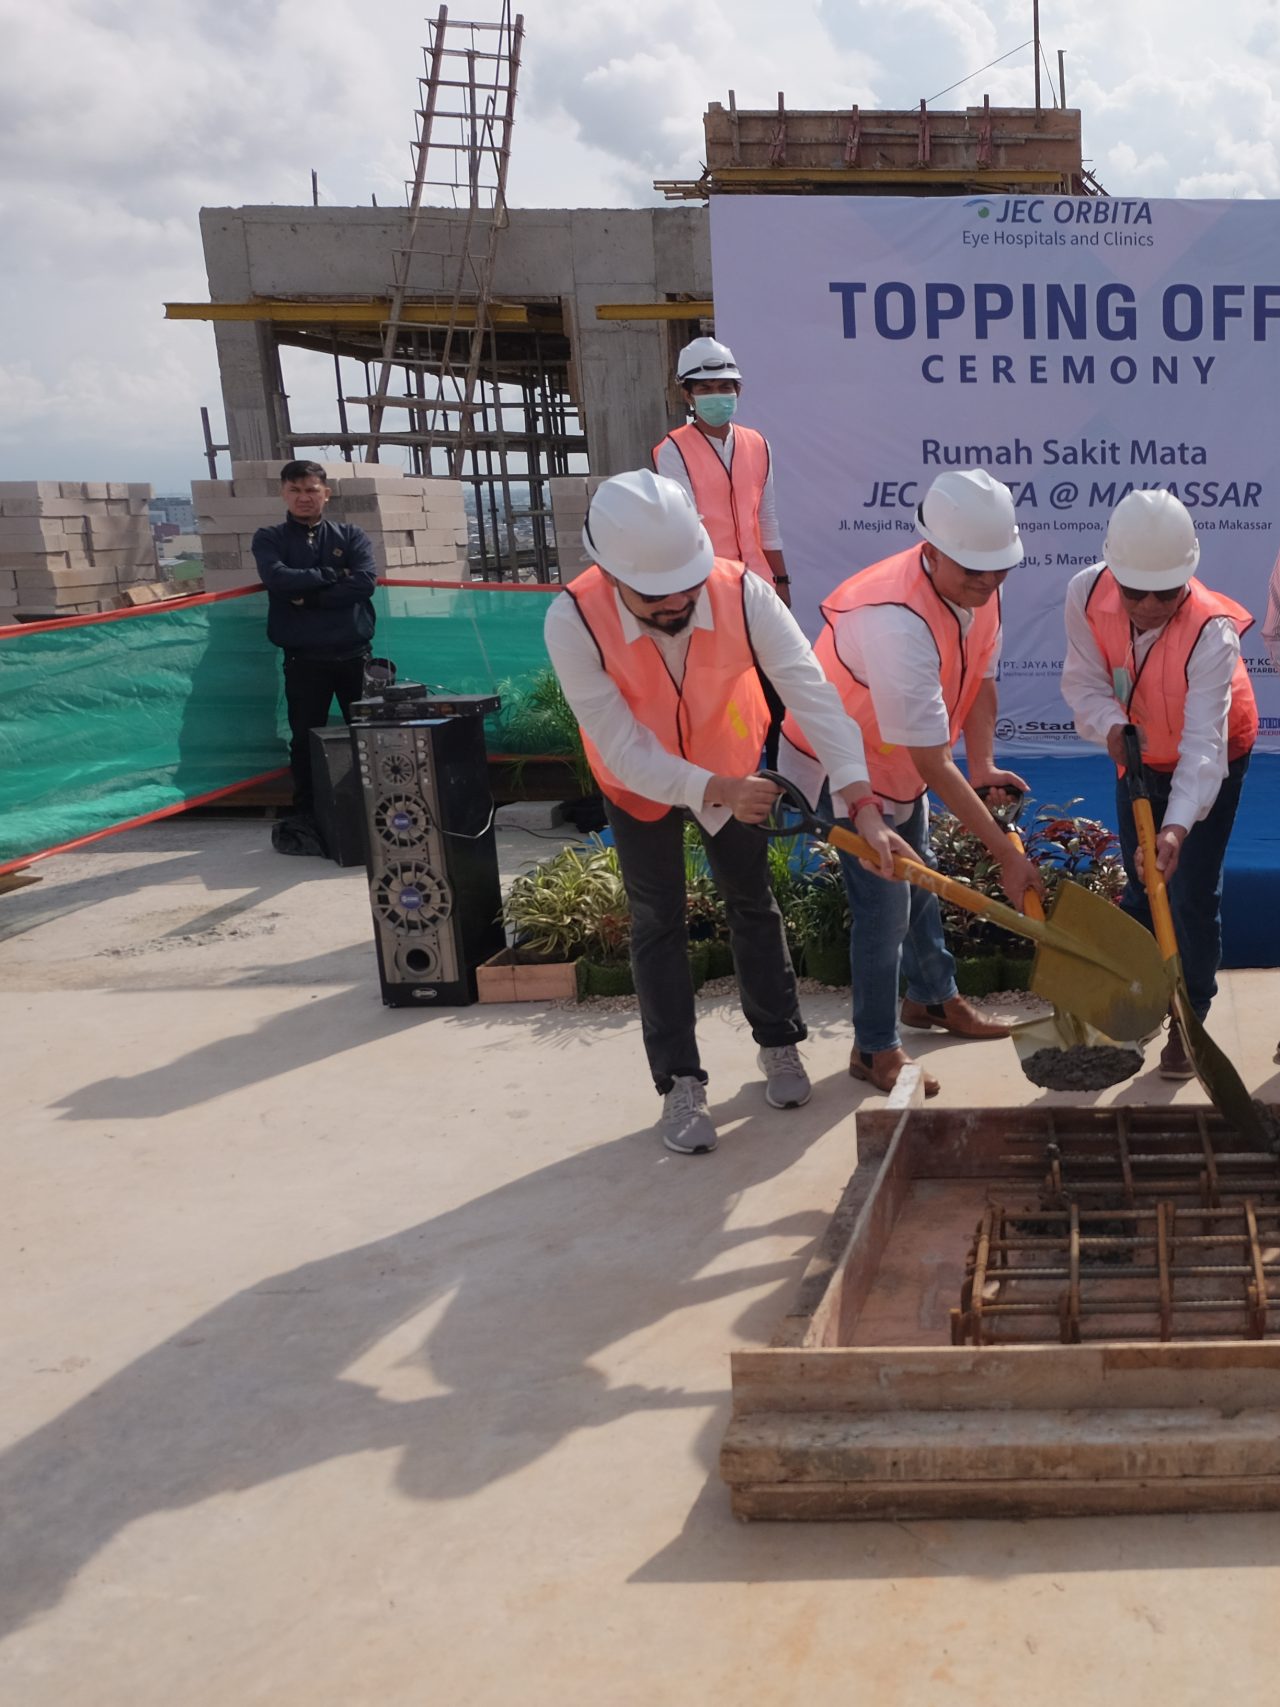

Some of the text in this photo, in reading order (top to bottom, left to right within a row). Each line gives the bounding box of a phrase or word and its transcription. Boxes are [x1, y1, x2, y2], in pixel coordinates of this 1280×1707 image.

[996, 200, 1152, 224] JEC ORBITA
[963, 231, 1154, 248] Eye Hospitals and Clinics
[829, 282, 1137, 341] TOPPING
[921, 354, 1216, 384] CEREMONY
[922, 438, 1207, 466] Rumah Sakit Mata
[863, 481, 918, 508] JEC
[1049, 481, 1079, 510] @
[838, 519, 850, 530] Jl.
[853, 519, 892, 533] Mesjid
[895, 519, 916, 533] Ray
[1053, 520, 1104, 533] Lompoa,
[1219, 520, 1272, 530] Makassar
[1044, 553, 1053, 565] 5
[1056, 553, 1097, 565] Maret
[1003, 660, 1018, 669] PT.
[1022, 660, 1048, 669] JAYA
